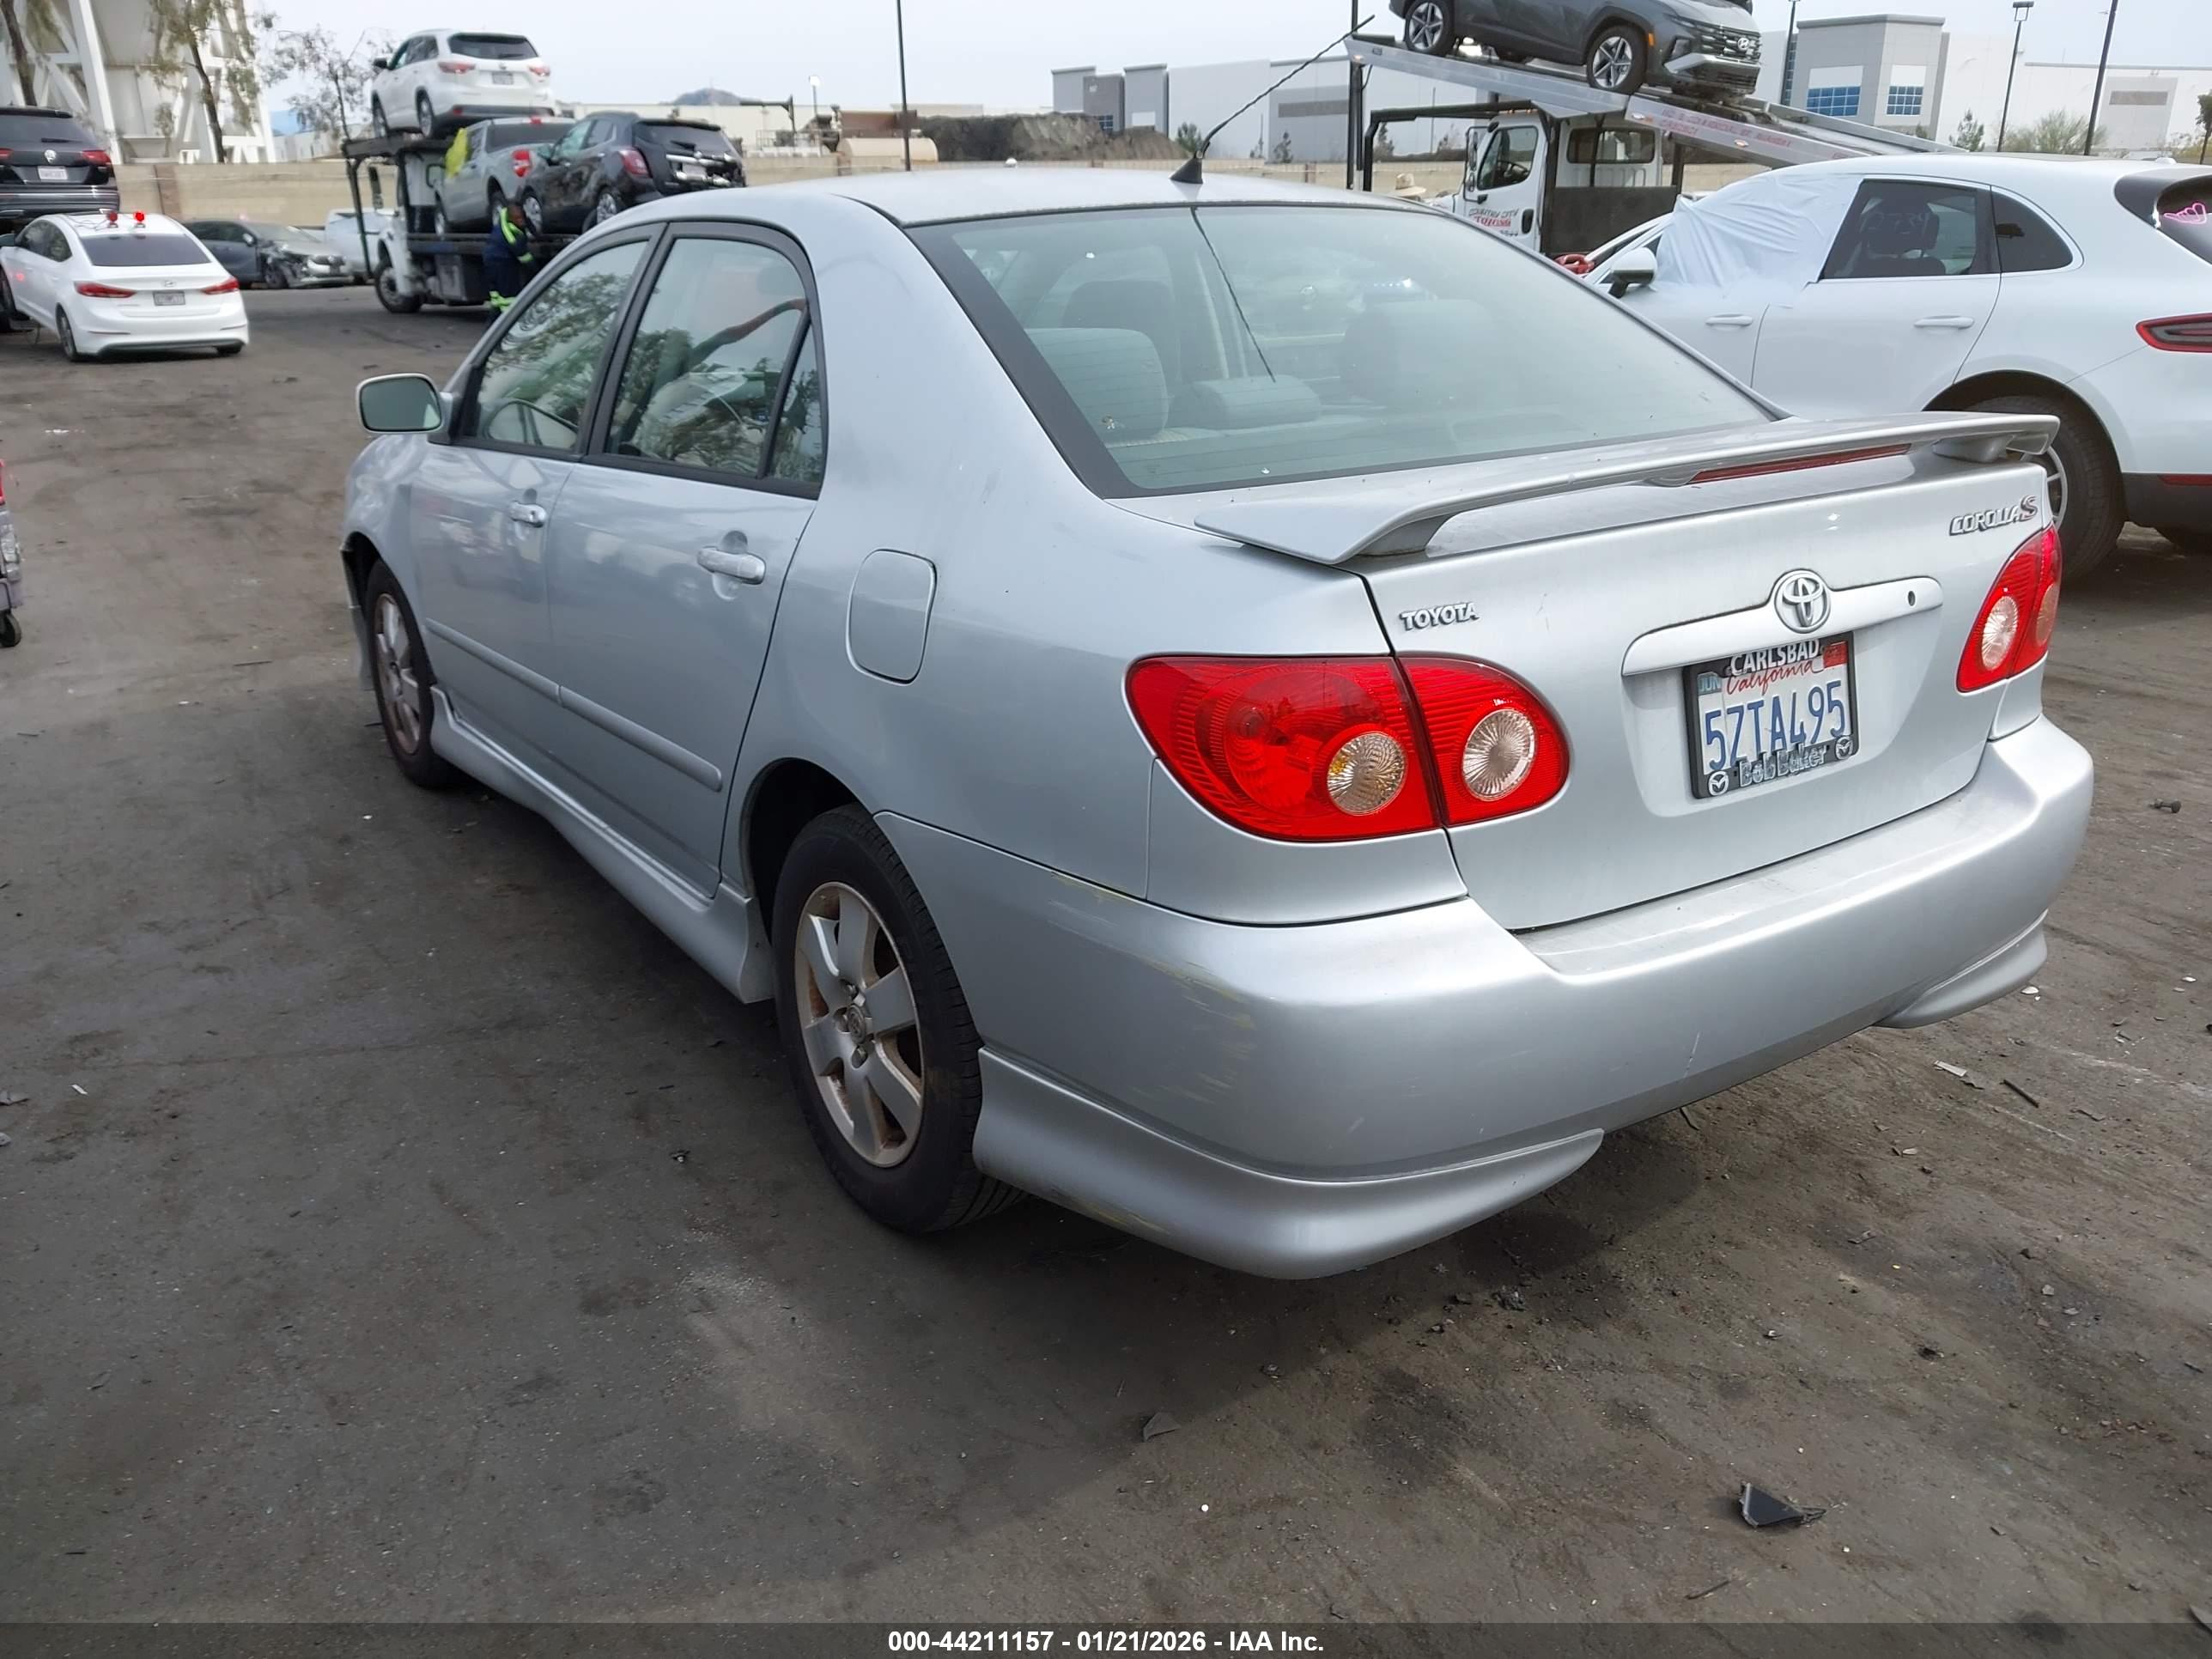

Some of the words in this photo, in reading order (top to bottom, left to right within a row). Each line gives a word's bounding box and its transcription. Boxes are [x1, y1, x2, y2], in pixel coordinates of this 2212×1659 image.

[1949, 506, 2021, 536] COROLLA
[2020, 495, 2038, 522] S
[1400, 602, 1480, 631] TOYOTA
[1730, 639, 1820, 676] CARLSBAD
[1726, 661, 1824, 696] California
[1705, 680, 1845, 769] 5ZTA495
[1739, 751, 1776, 787] Bob
